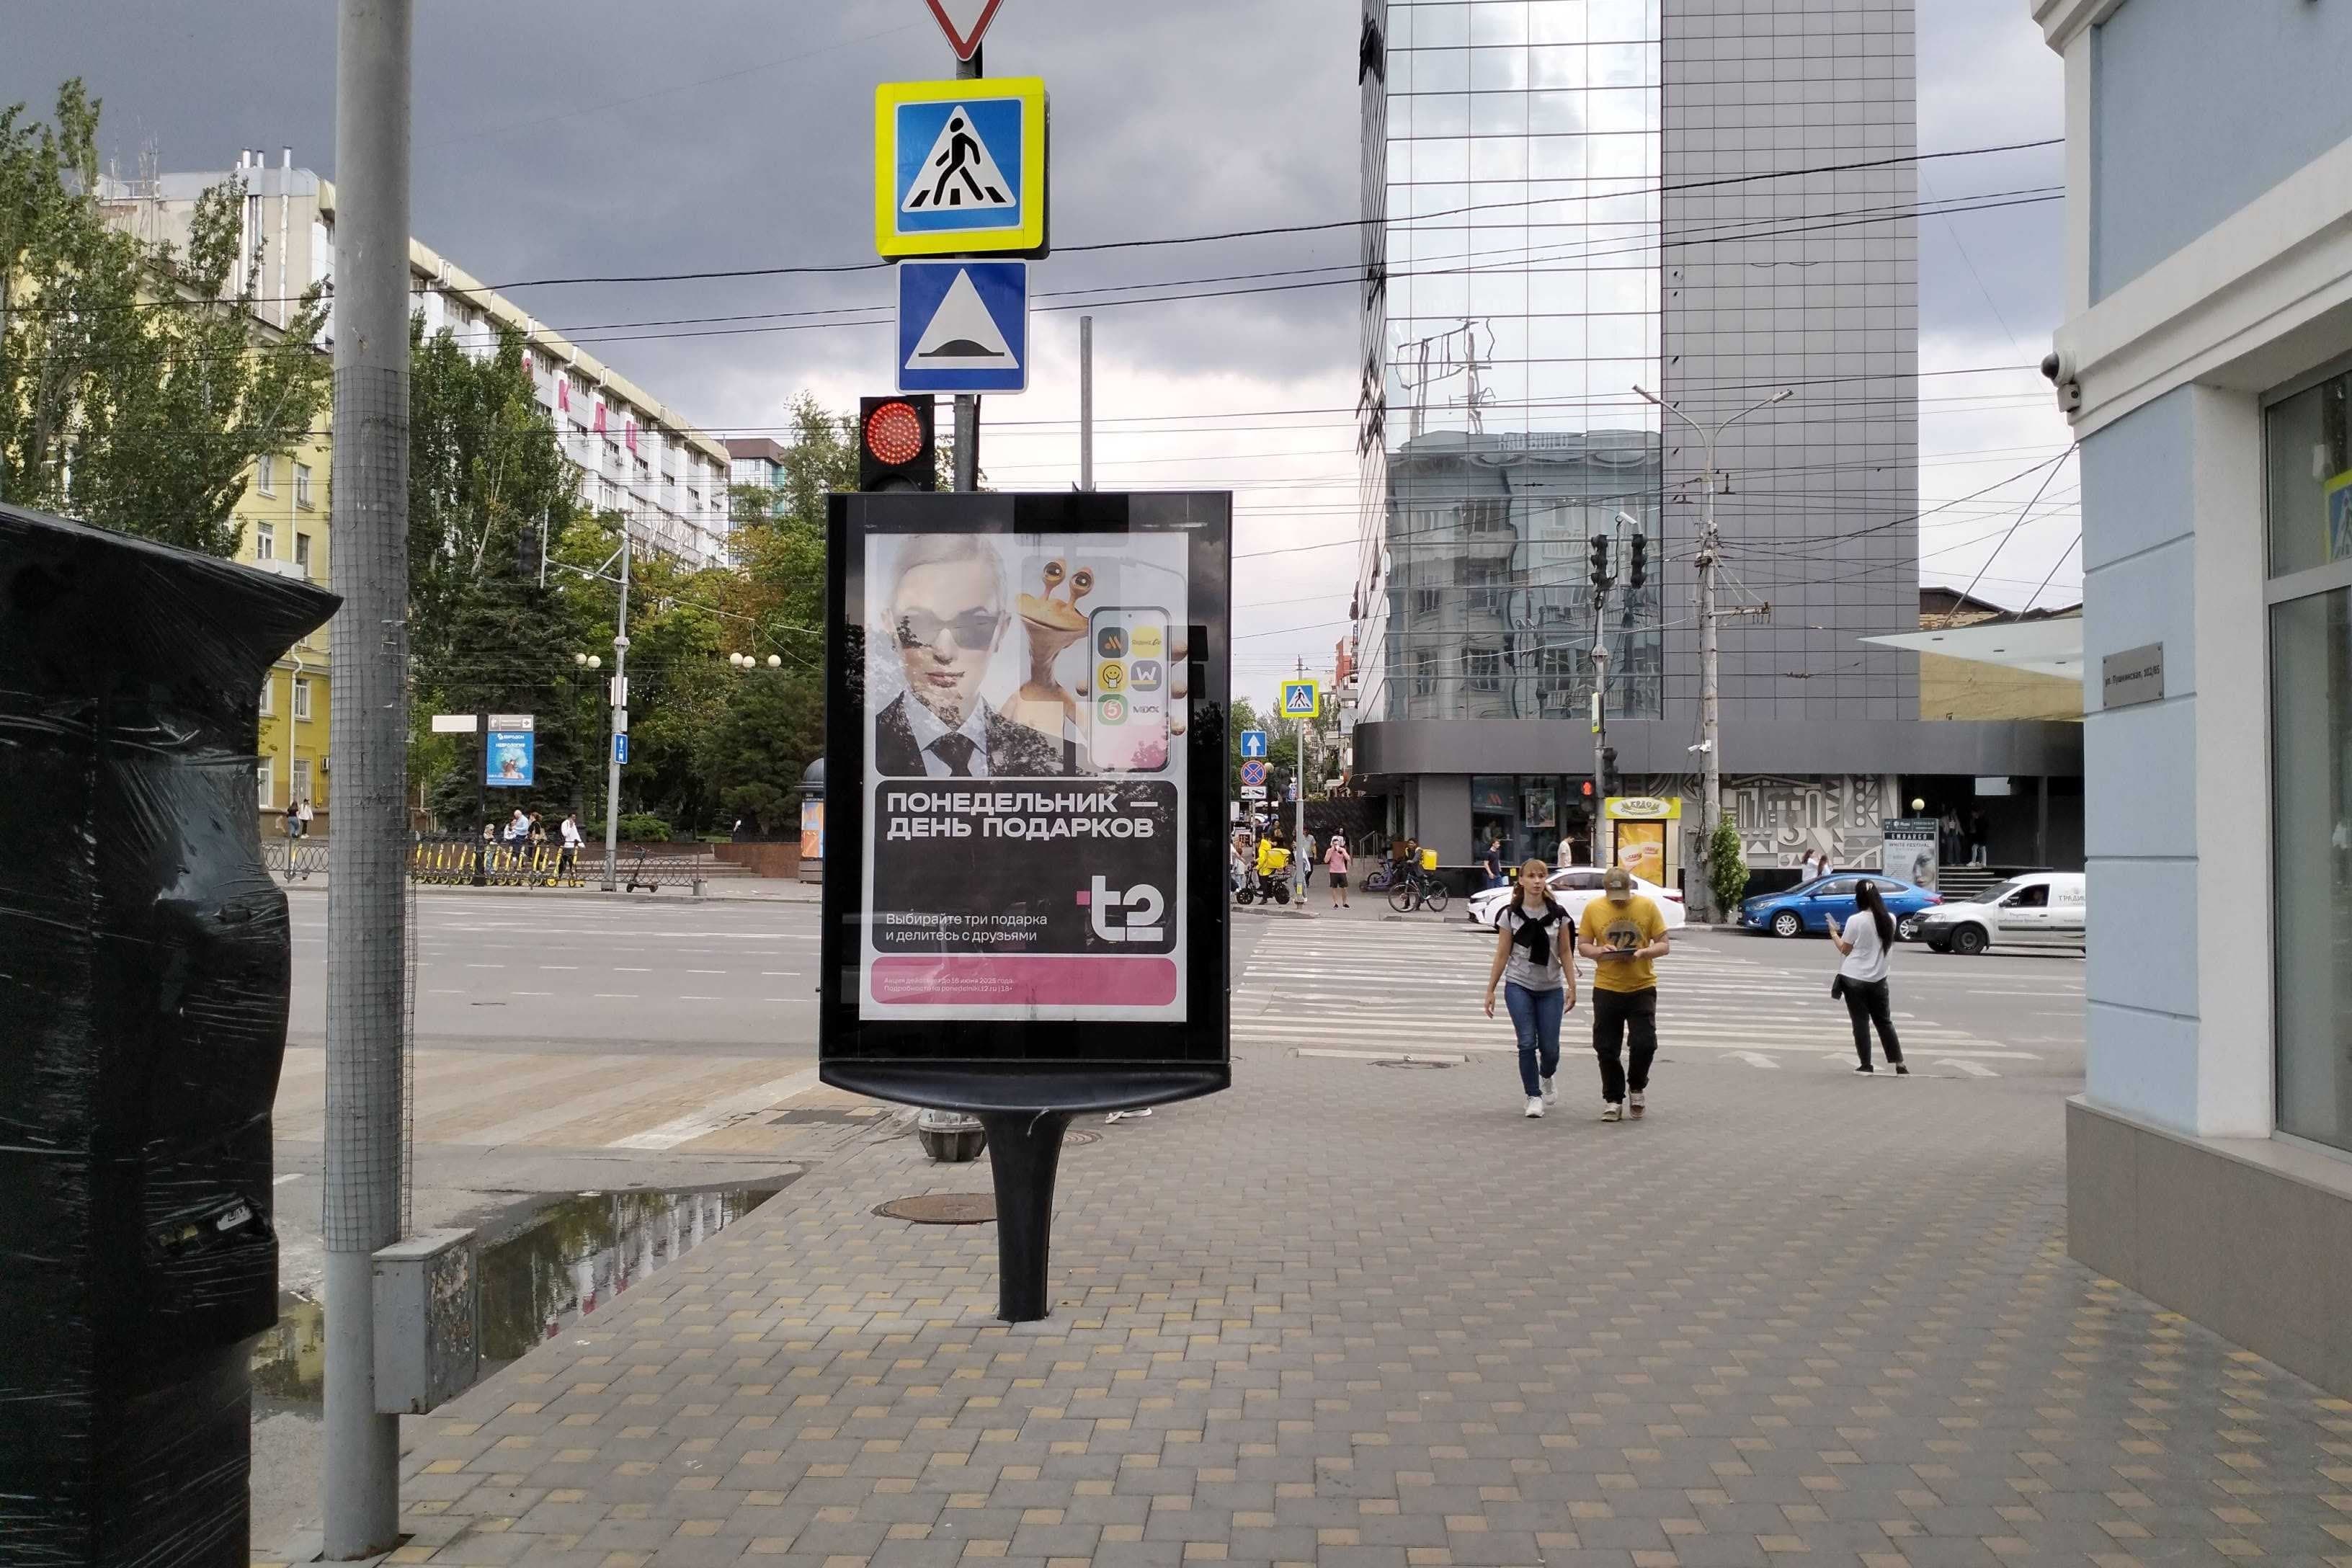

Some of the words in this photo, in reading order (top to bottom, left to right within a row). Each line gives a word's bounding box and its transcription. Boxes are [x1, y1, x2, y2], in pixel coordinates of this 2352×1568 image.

[887, 793, 1118, 816] ПОНЕДЕЛЬНИК
[887, 818, 972, 841] ДЕНЬ
[983, 818, 1154, 841] ПОДАРКОВ
[886, 913, 962, 927] Выбирайте
[965, 916, 988, 927] три
[991, 916, 1047, 927] подарка
[896, 932, 960, 943] делитесь
[961, 932, 970, 941] с
[971, 932, 1037, 943] друзьями
[1608, 930, 1636, 949] 72
